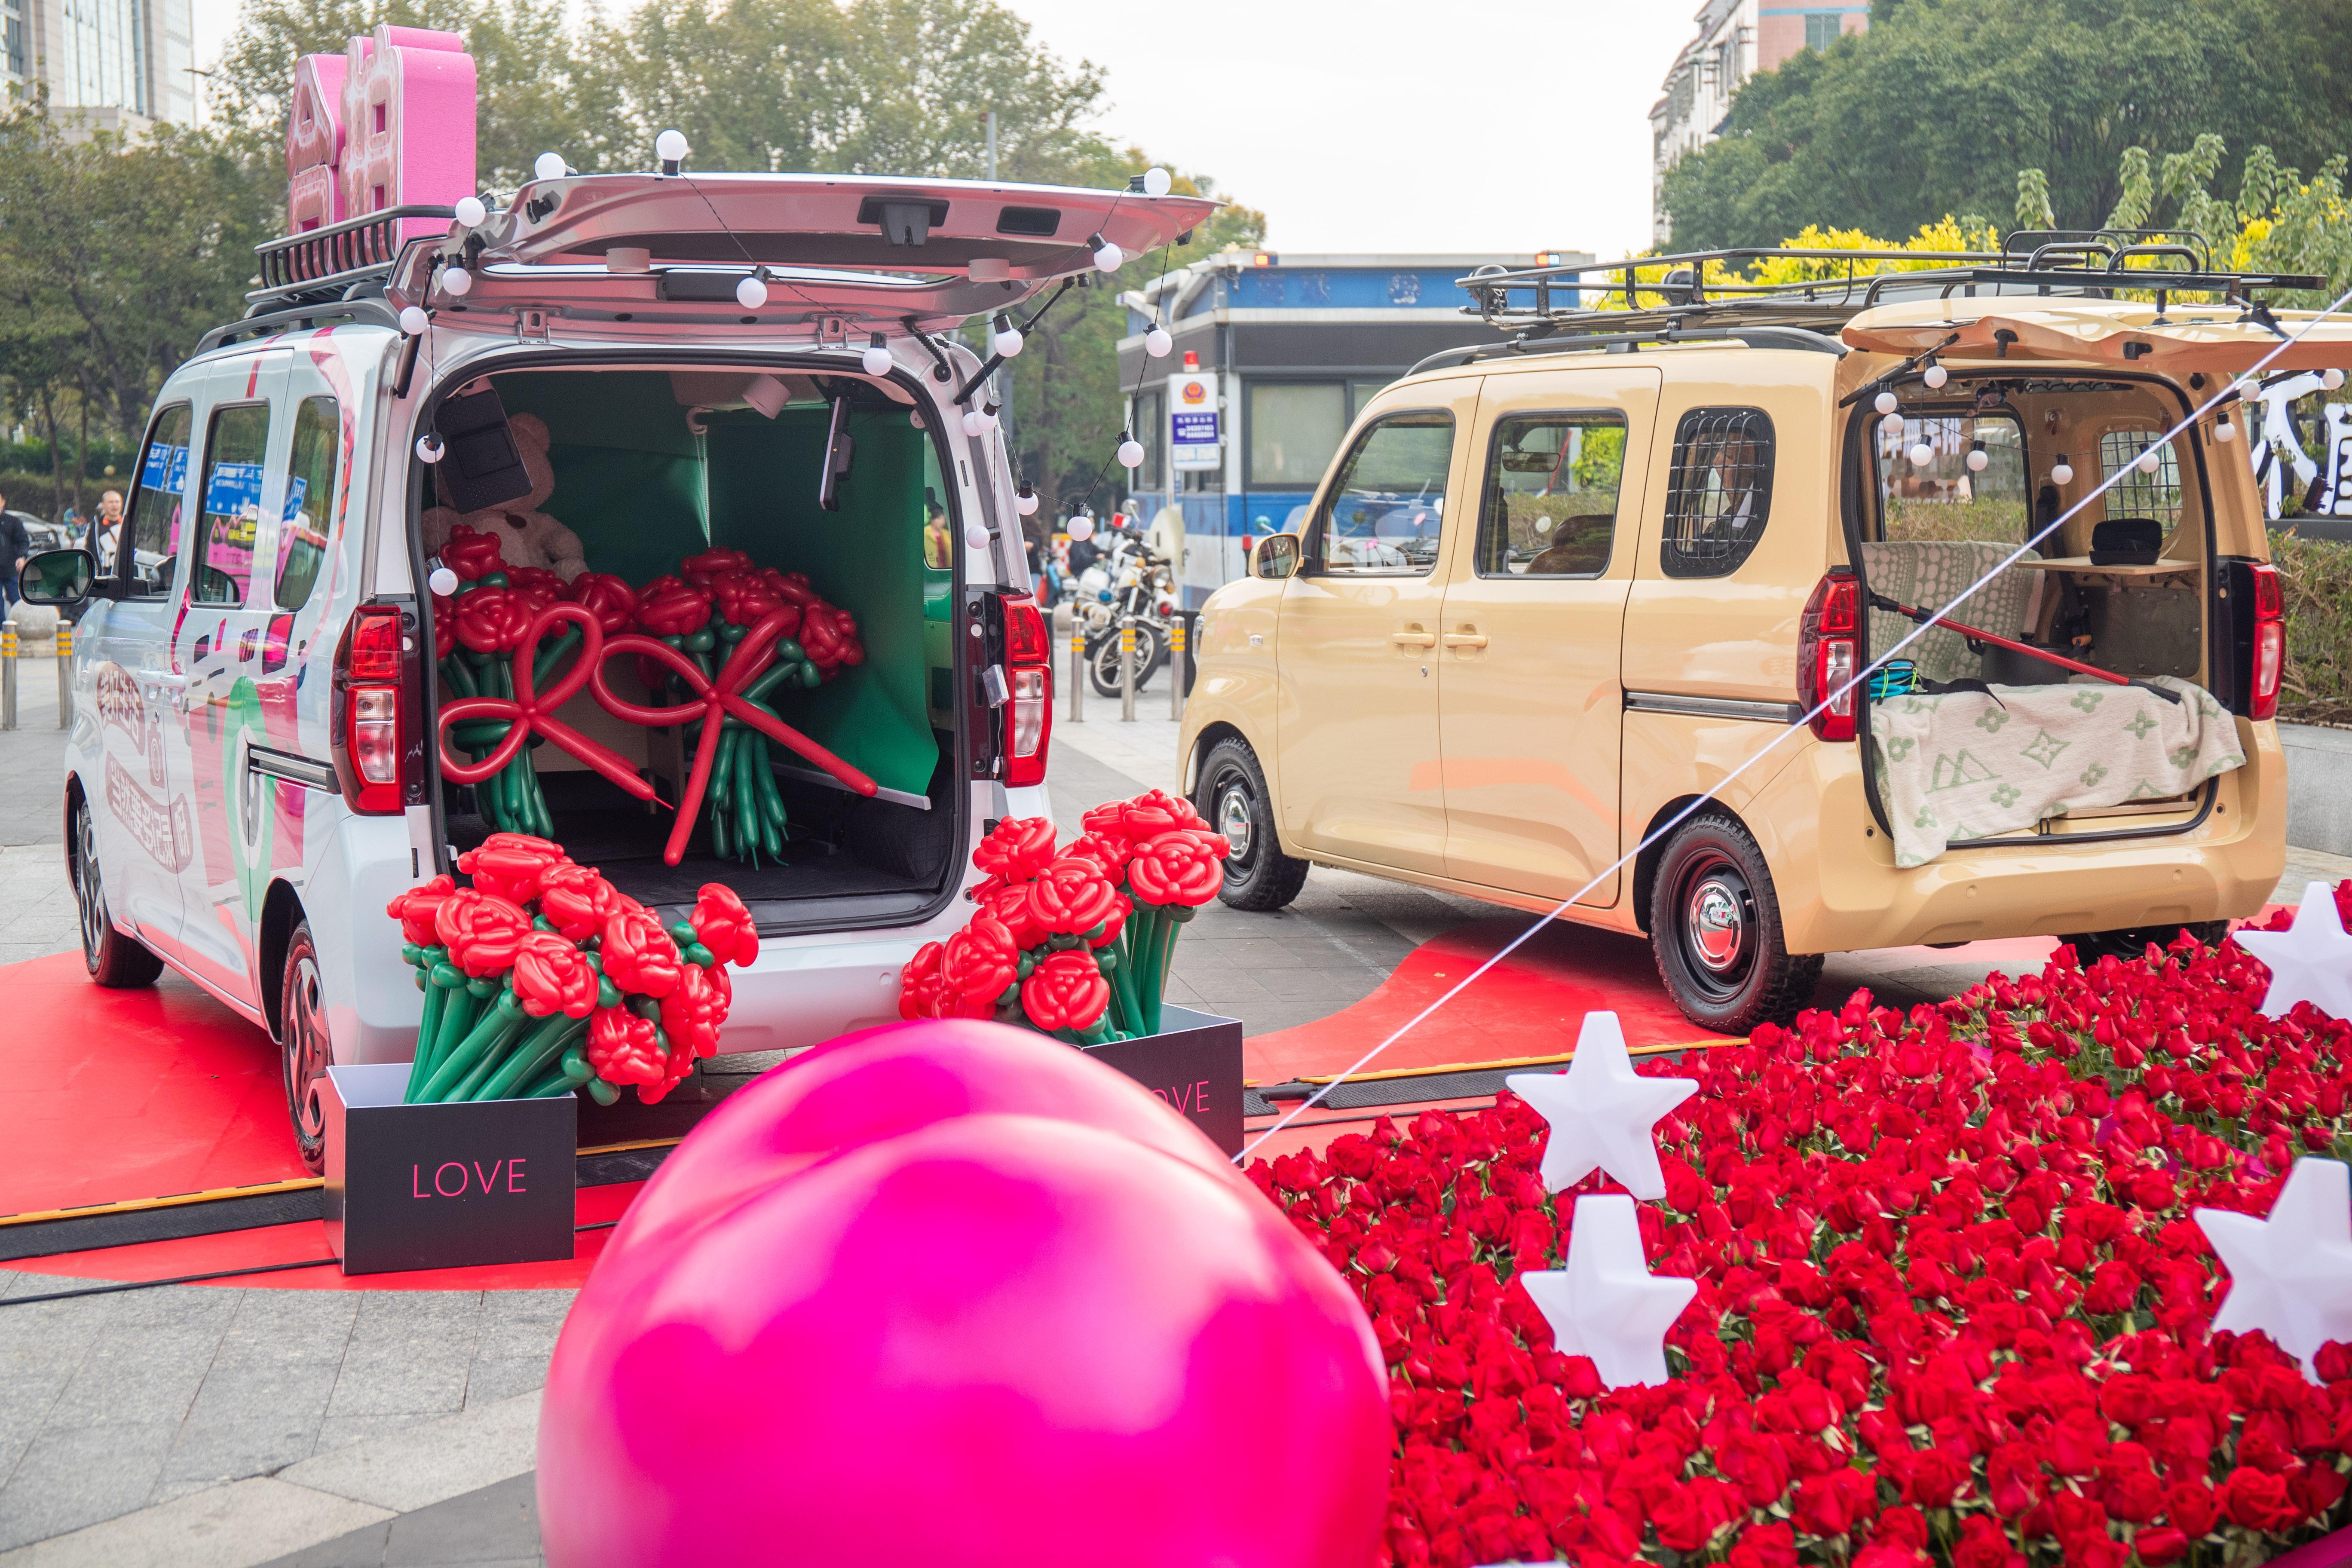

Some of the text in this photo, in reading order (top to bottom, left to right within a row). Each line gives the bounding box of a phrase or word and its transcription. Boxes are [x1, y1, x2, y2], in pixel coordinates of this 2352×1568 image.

[101, 669, 140, 744] 美好生活
[413, 1158, 527, 1198] LOVE
